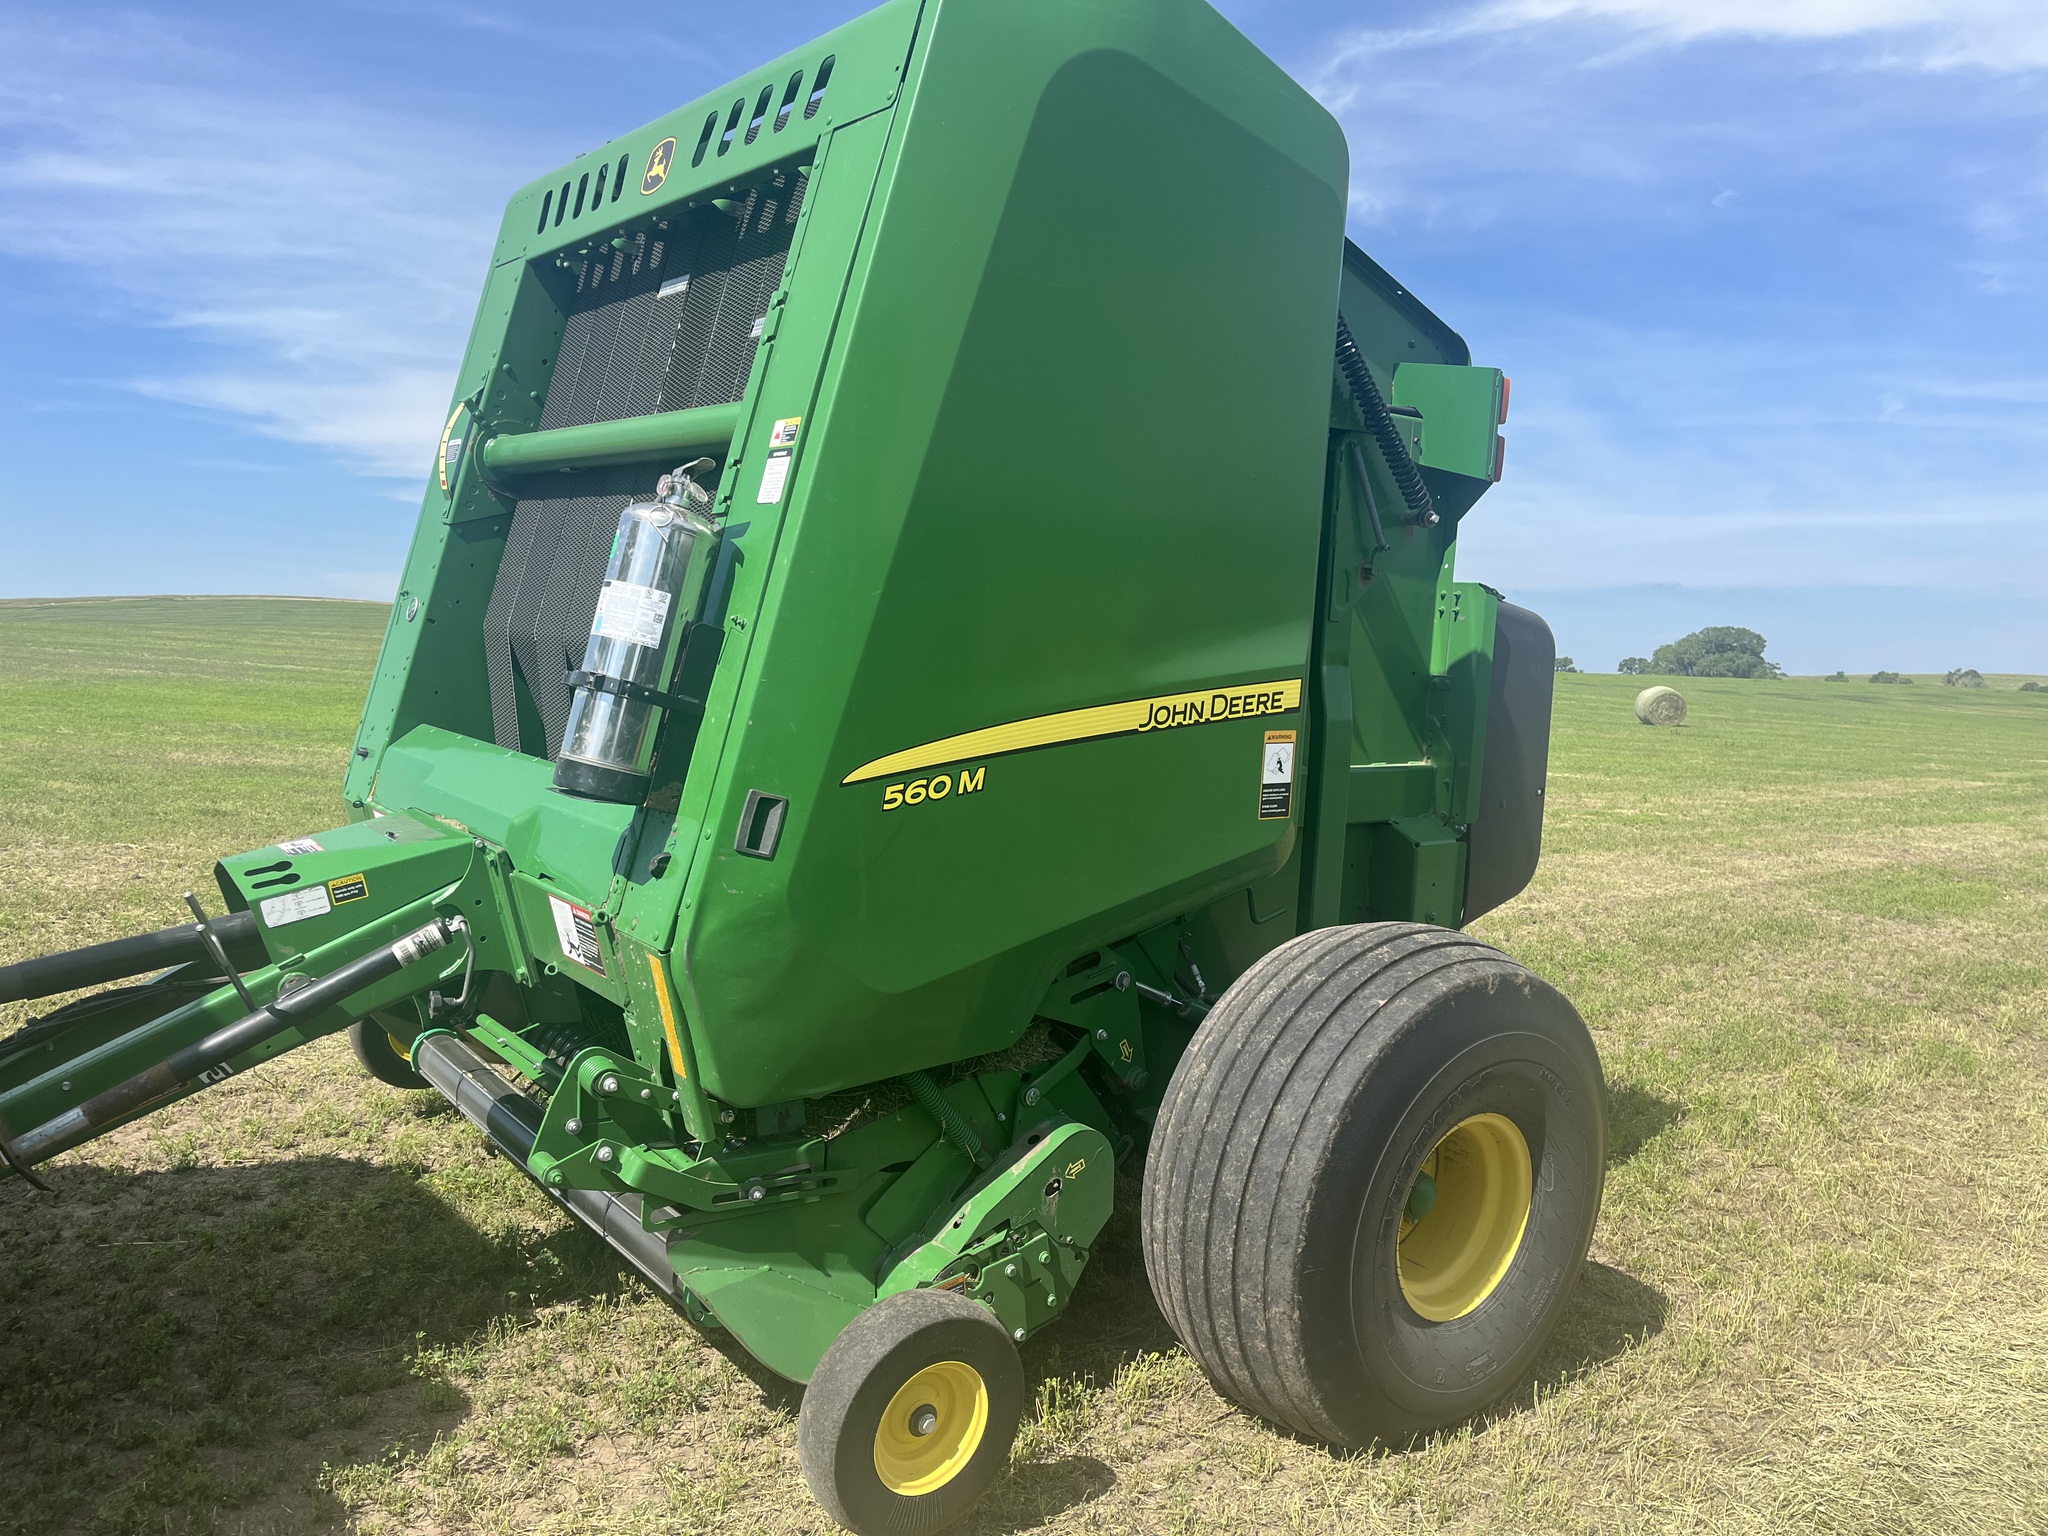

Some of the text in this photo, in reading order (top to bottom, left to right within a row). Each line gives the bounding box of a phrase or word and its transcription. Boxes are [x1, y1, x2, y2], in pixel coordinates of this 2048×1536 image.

[1138, 691, 1285, 730] JOHN DEERE
[882, 765, 988, 811] 560 M
[336, 877, 362, 886] CAUTION
